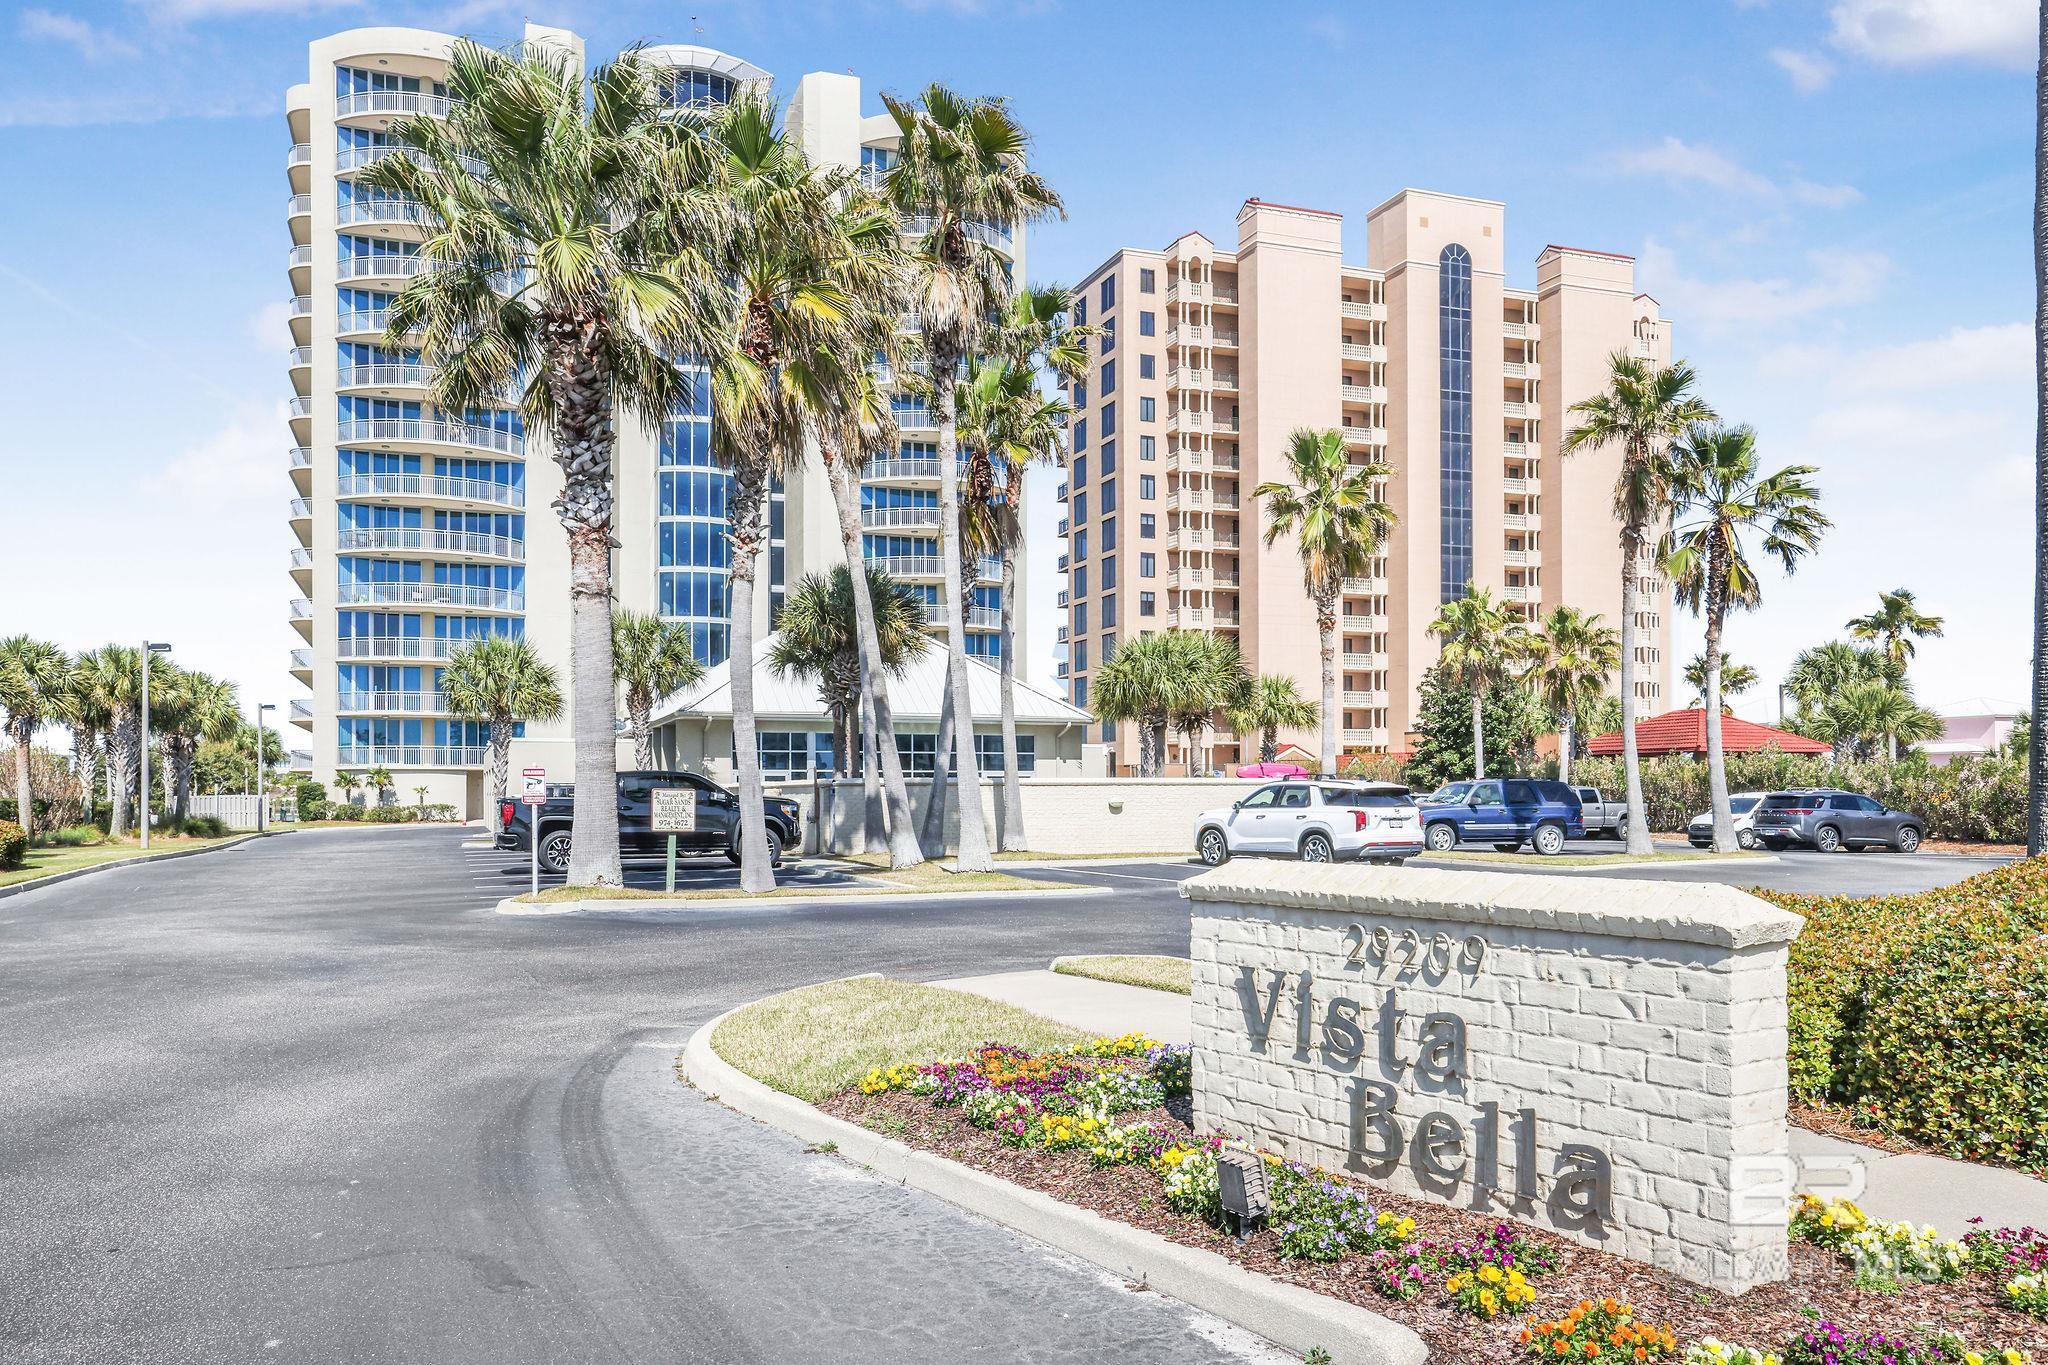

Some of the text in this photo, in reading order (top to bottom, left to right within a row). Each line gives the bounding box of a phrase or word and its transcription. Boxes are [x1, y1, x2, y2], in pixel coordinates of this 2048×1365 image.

[1346, 922, 1488, 978] 29209
[1241, 966, 1467, 1080] Vista
[1349, 1077, 1614, 1223] Bella
